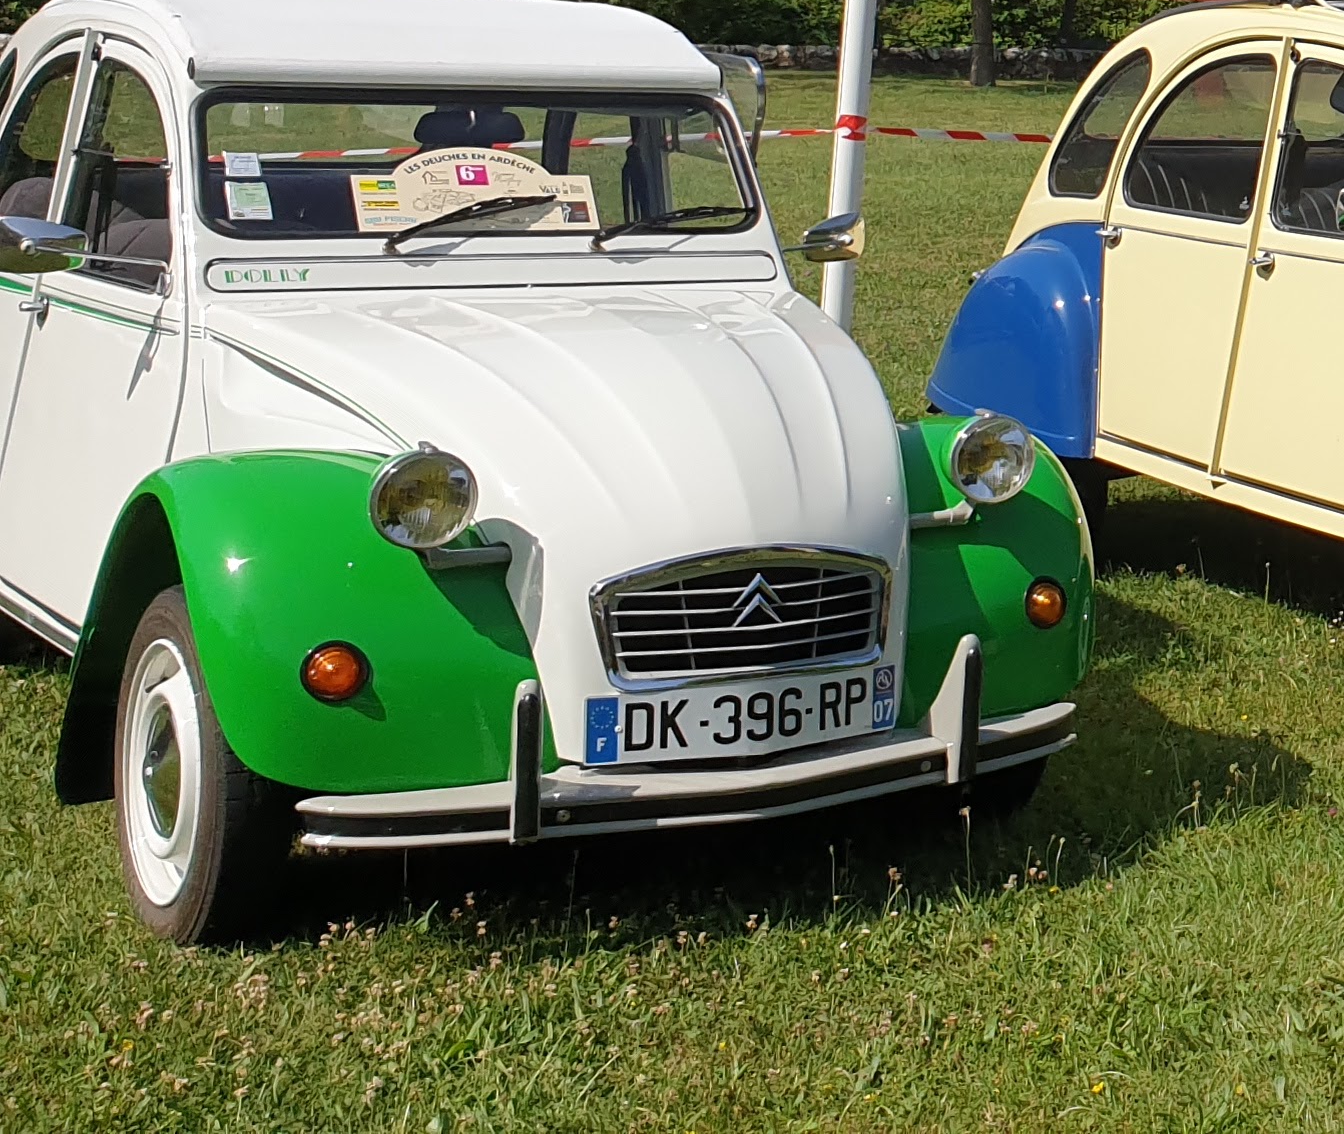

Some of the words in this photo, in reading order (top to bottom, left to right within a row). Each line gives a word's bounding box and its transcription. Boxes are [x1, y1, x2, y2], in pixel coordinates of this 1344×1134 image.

[404, 162, 421, 175] LES
[421, 152, 469, 167] DEUCHES
[471, 153, 486, 161] EN
[488, 155, 536, 175] ARDÈCHE
[224, 268, 310, 284] DOLLY
[622, 677, 868, 753] DK-396-RP
[873, 697, 894, 723] 07
[596, 736, 606, 753] F
